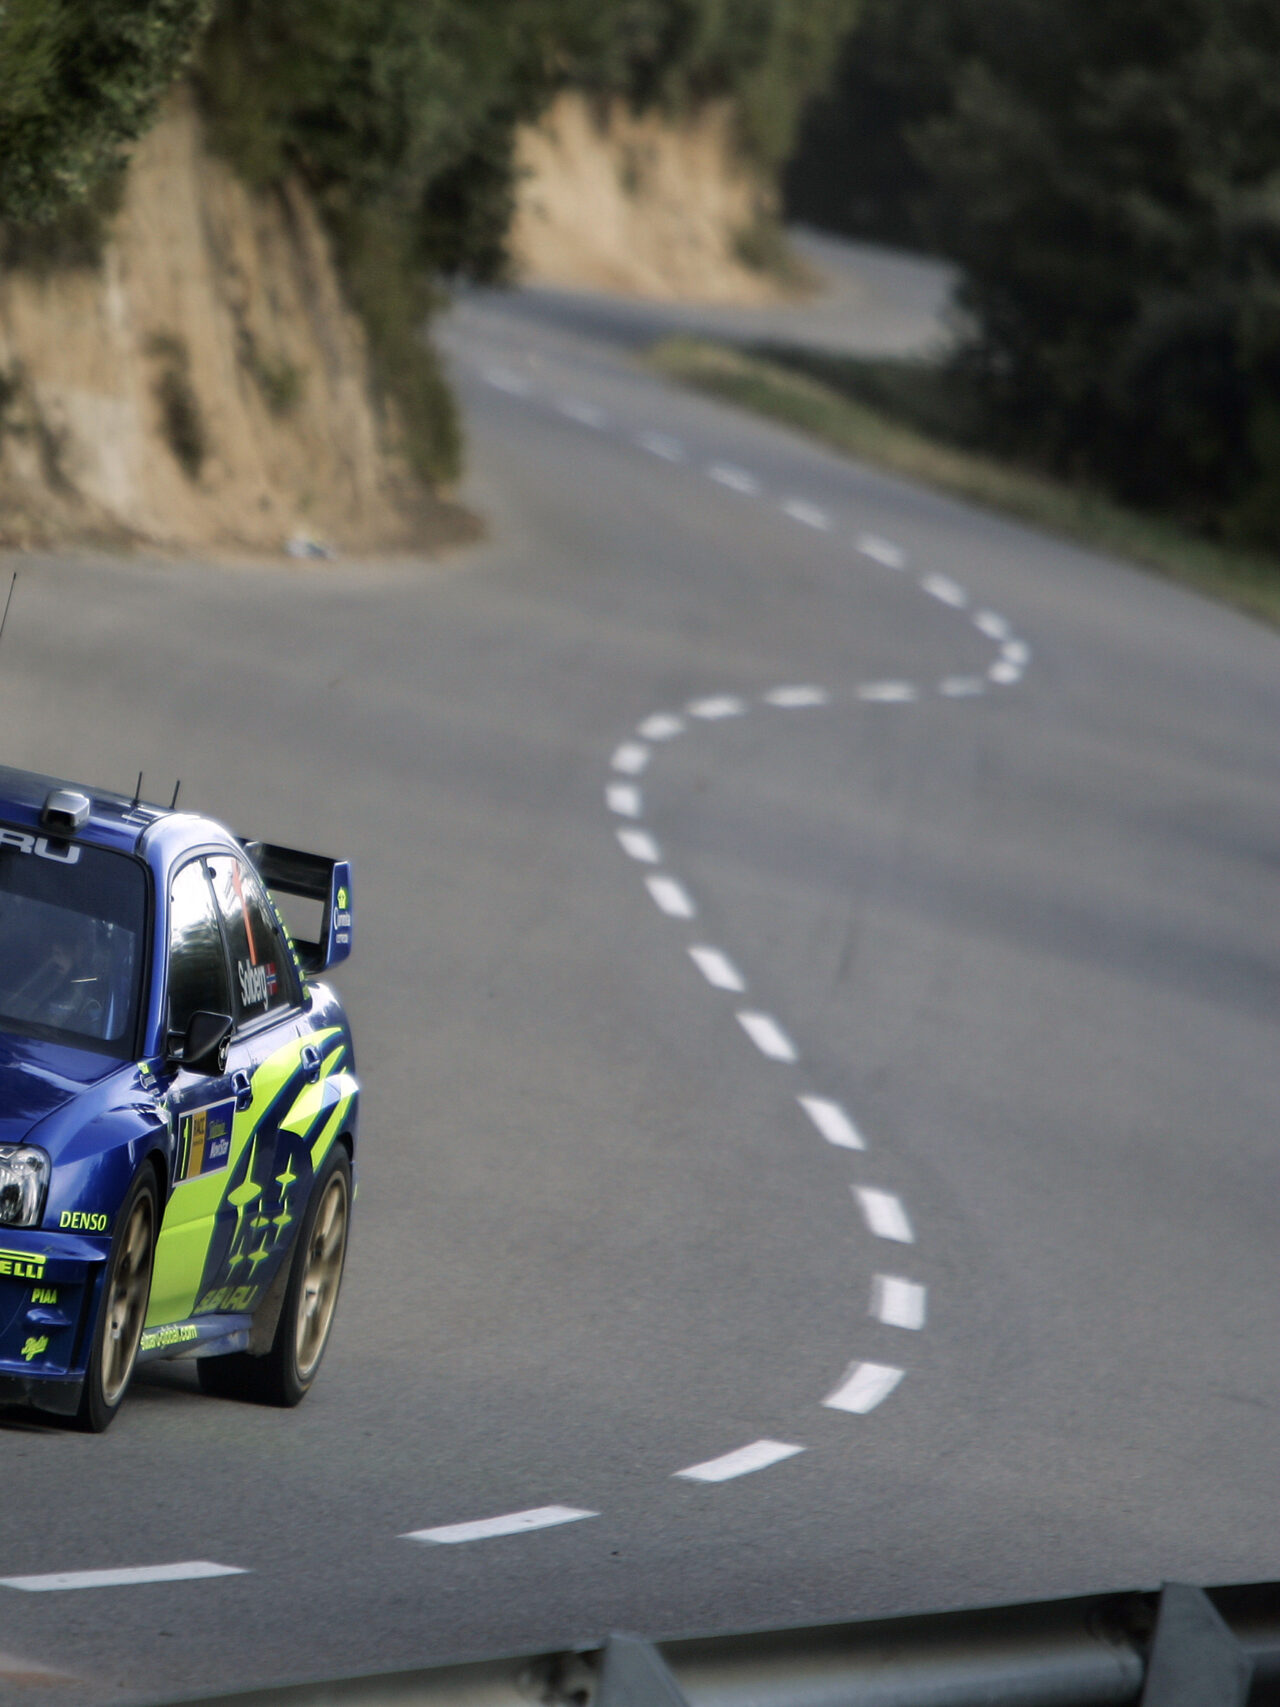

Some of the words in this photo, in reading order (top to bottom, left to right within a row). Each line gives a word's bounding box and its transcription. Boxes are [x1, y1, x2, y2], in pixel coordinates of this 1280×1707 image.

[238, 958, 269, 1012] Solberg
[180, 1117, 190, 1180] 1
[59, 1211, 108, 1232] DENSO
[31, 1287, 58, 1305] PIAA
